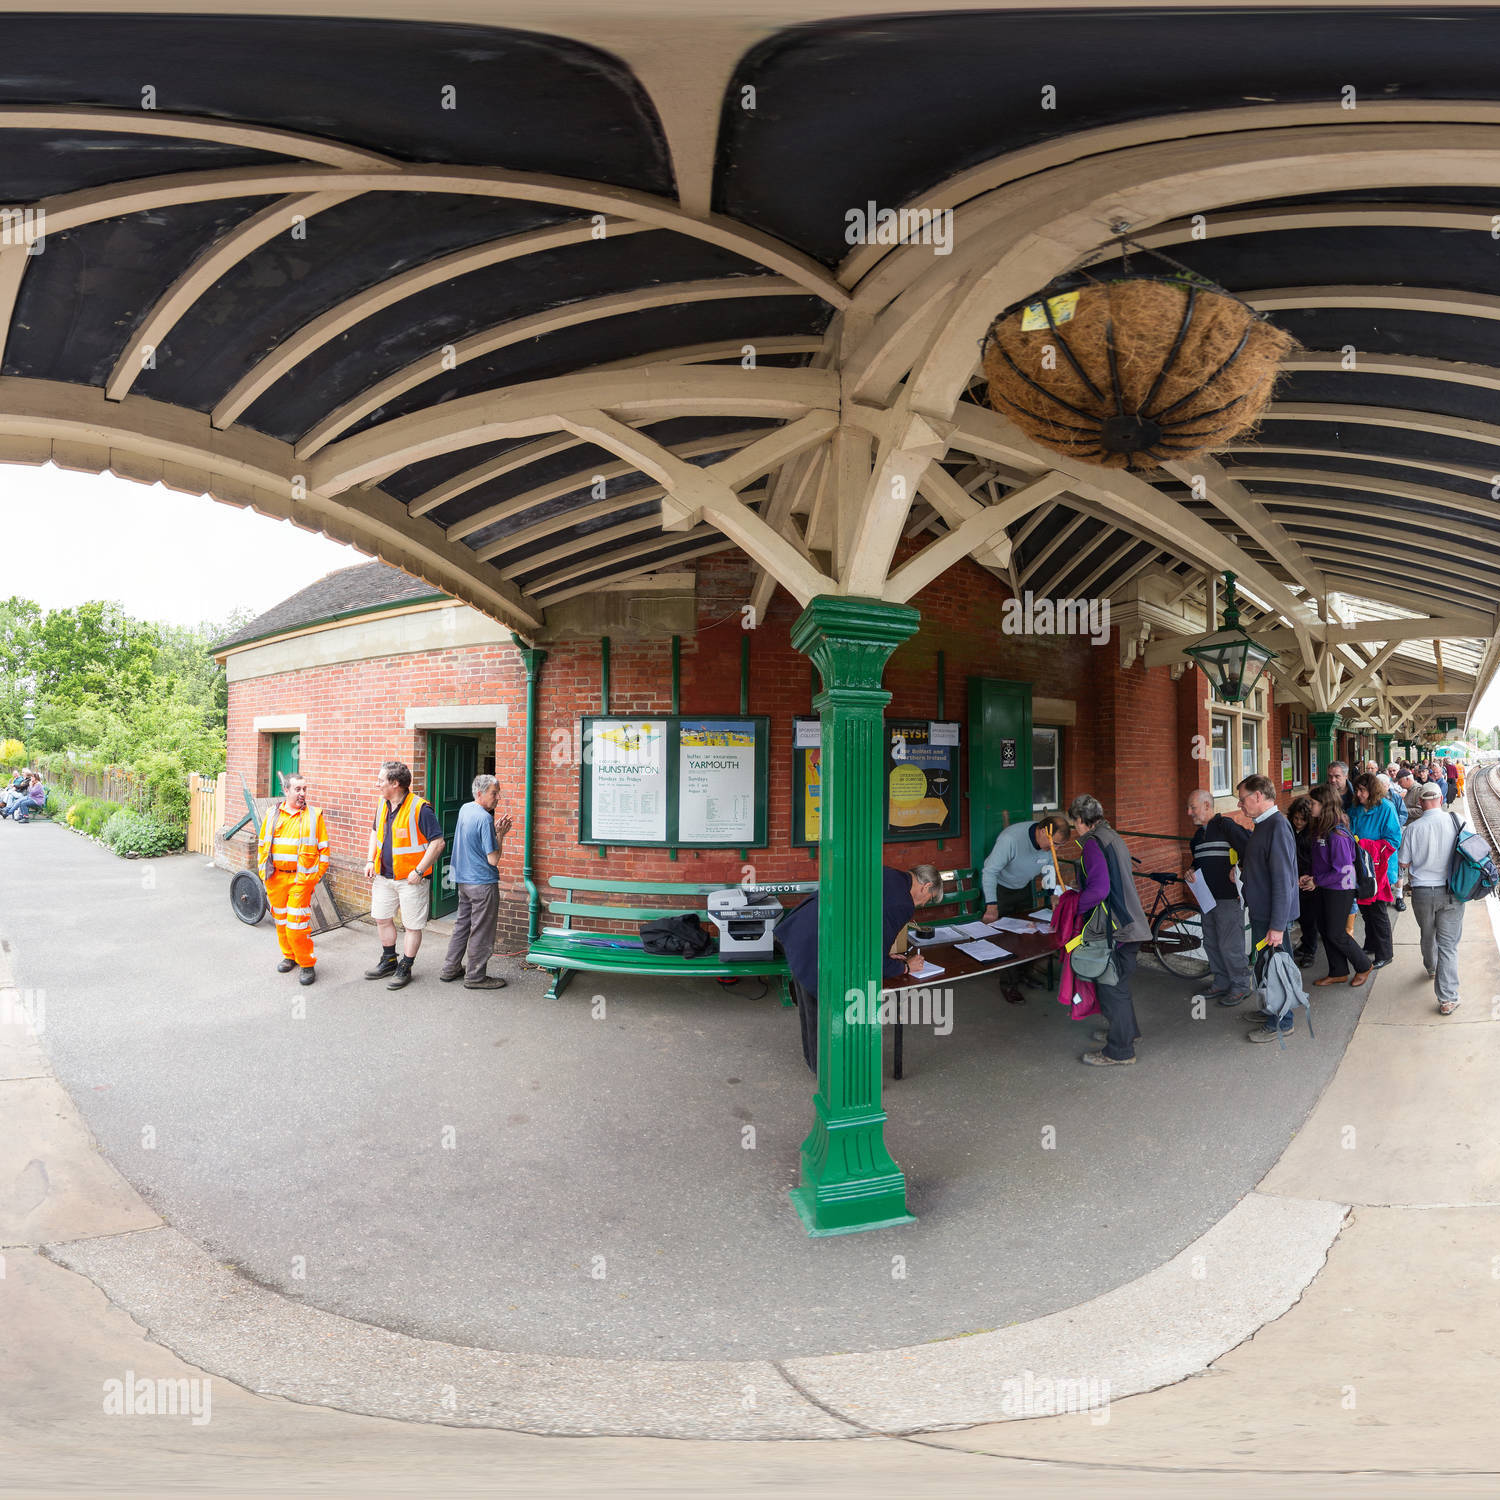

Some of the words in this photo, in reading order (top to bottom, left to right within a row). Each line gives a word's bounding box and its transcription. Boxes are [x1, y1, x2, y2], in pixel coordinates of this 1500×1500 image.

[688, 760, 740, 769] YARMOUTH
[598, 765, 659, 775] HUNSTANTON
[749, 884, 801, 893] KINGSCOTE
